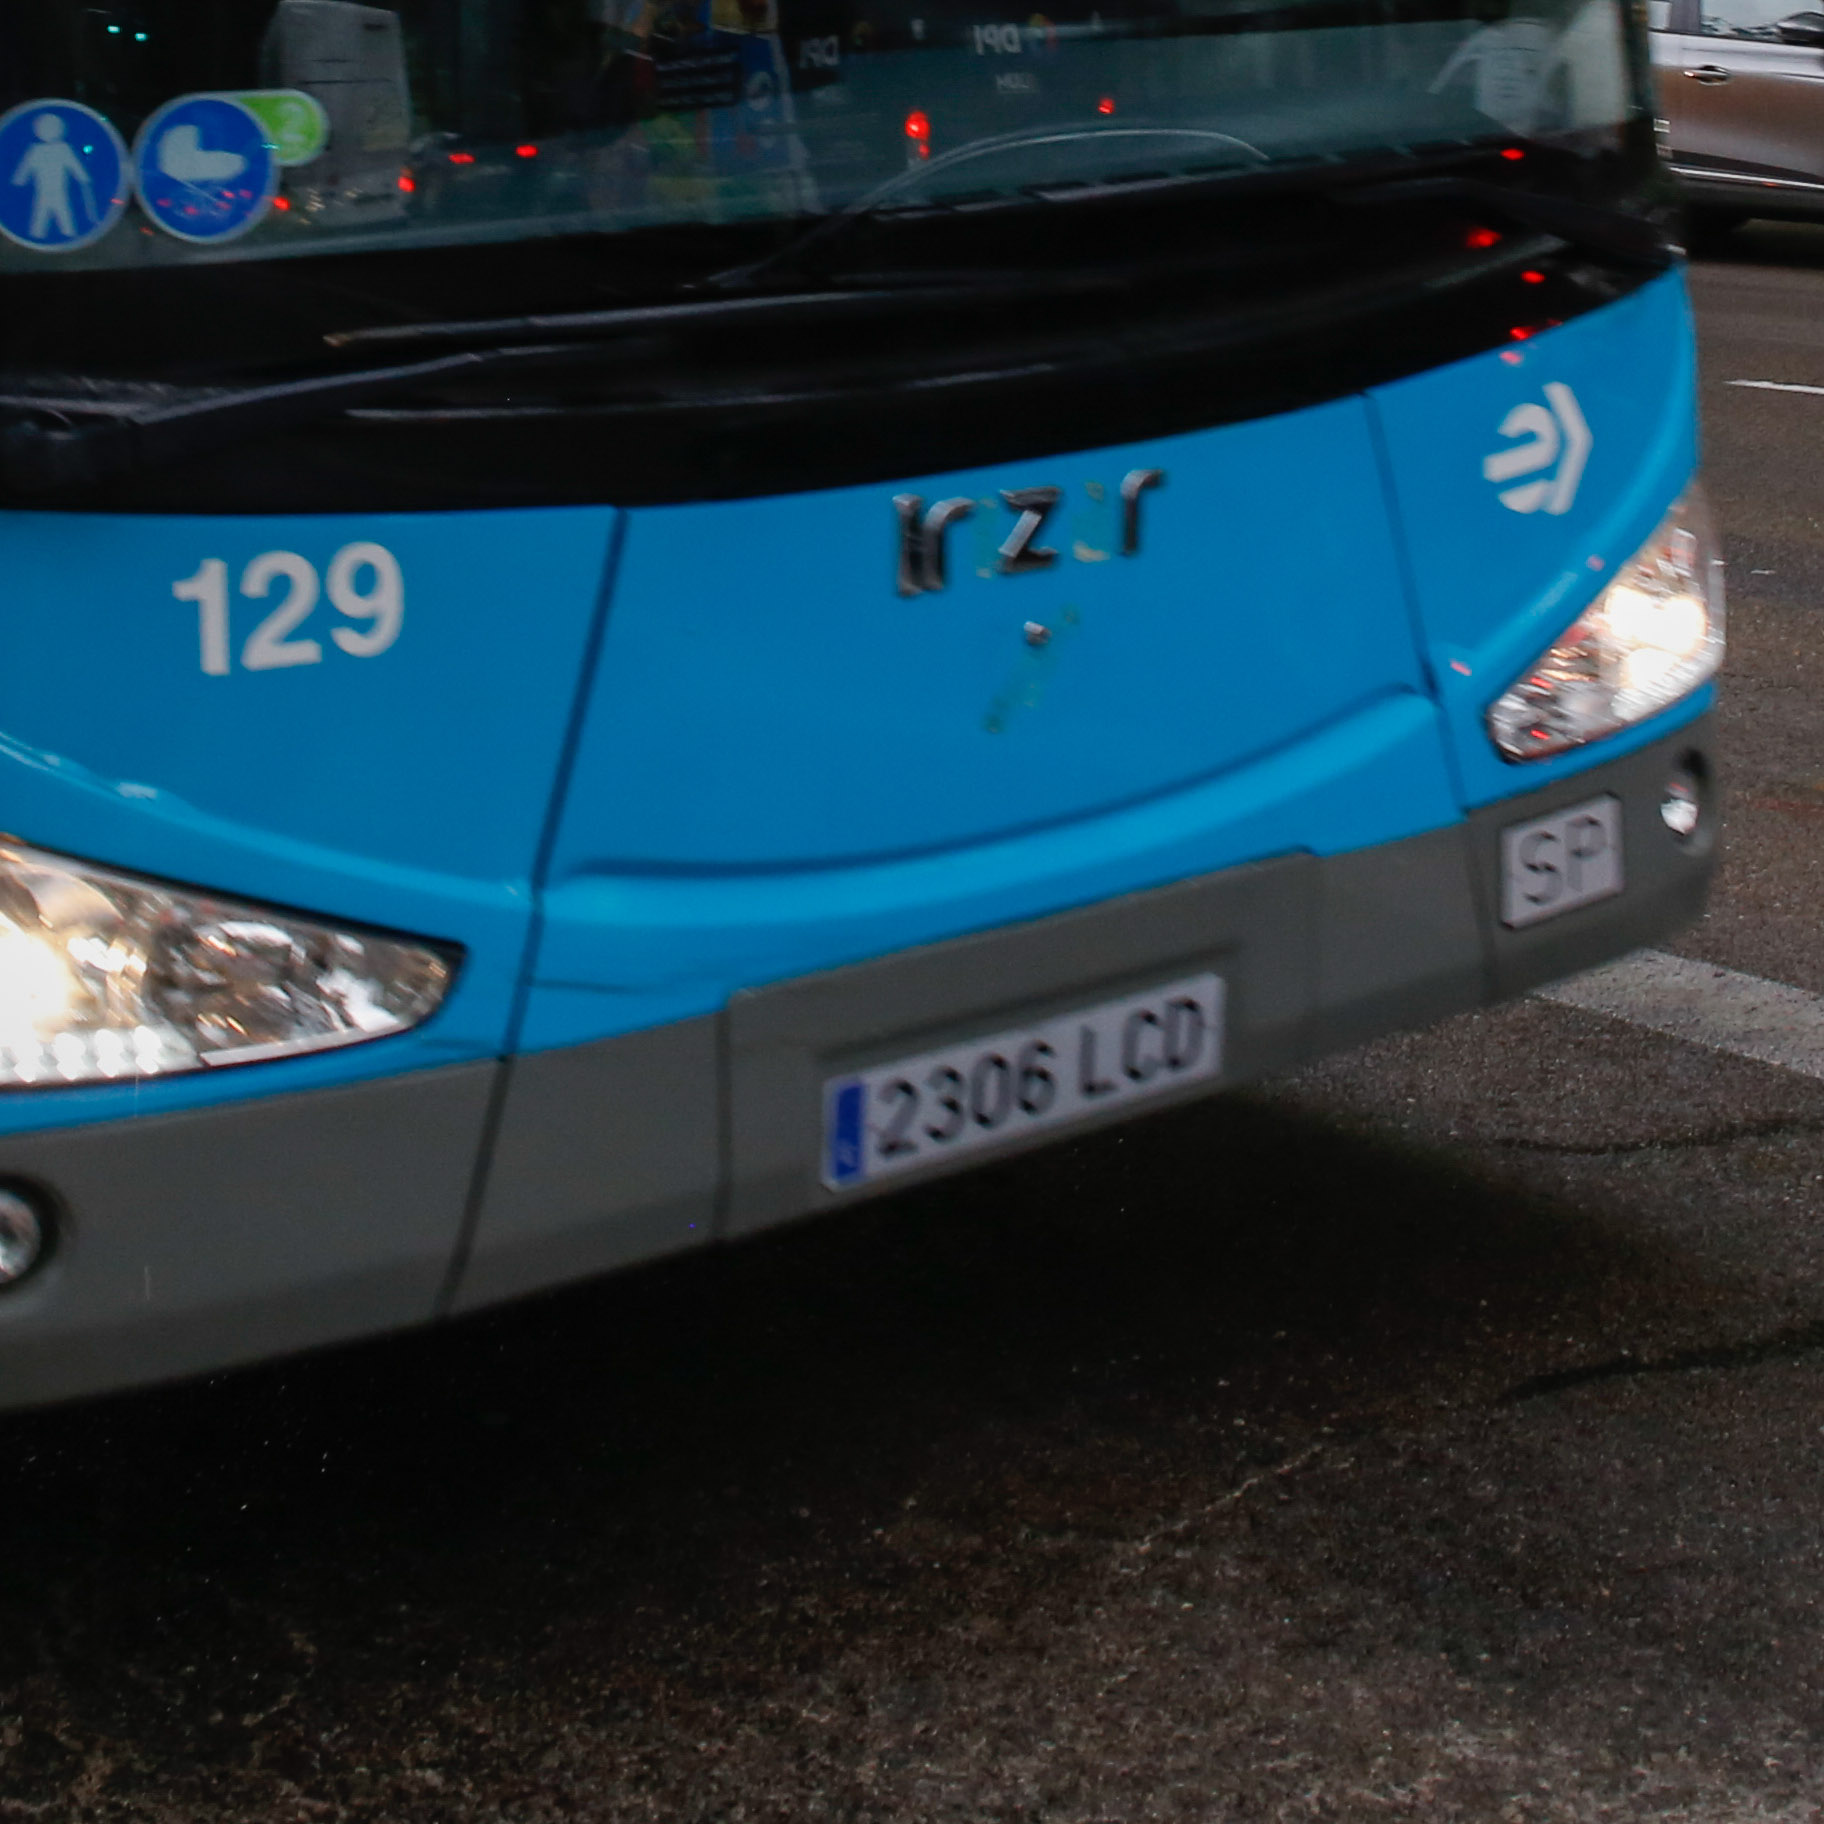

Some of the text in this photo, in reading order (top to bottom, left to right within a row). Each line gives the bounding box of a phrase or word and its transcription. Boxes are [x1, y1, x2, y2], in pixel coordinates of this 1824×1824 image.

[172, 541, 405, 676] 129
[1519, 815, 1609, 905] SP
[878, 996, 1206, 1156] 2306 LCD
